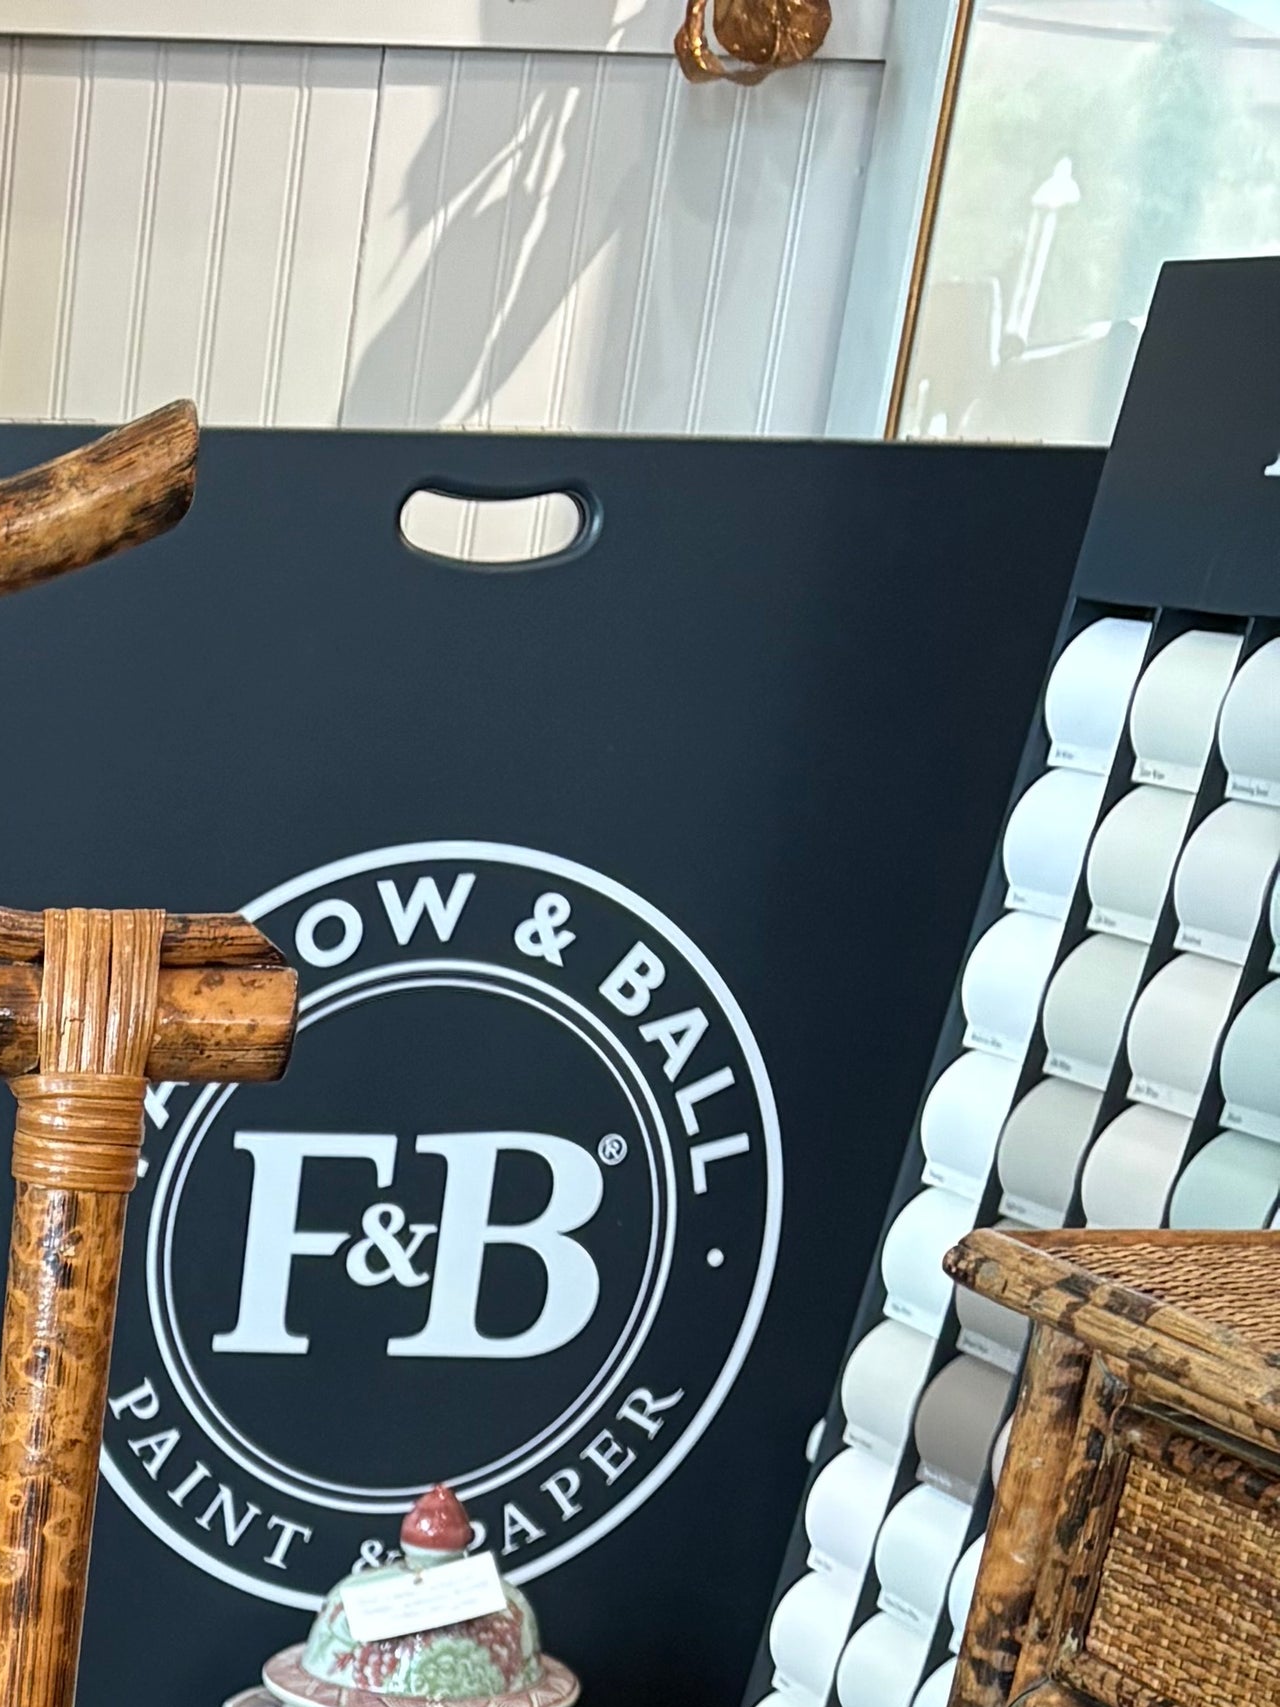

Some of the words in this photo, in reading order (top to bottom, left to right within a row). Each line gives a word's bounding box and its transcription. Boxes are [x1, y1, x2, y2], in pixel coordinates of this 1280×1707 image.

[513, 890, 577, 969] &
[598, 939, 751, 1195] BALL
[108, 1376, 313, 1570] PAINT
